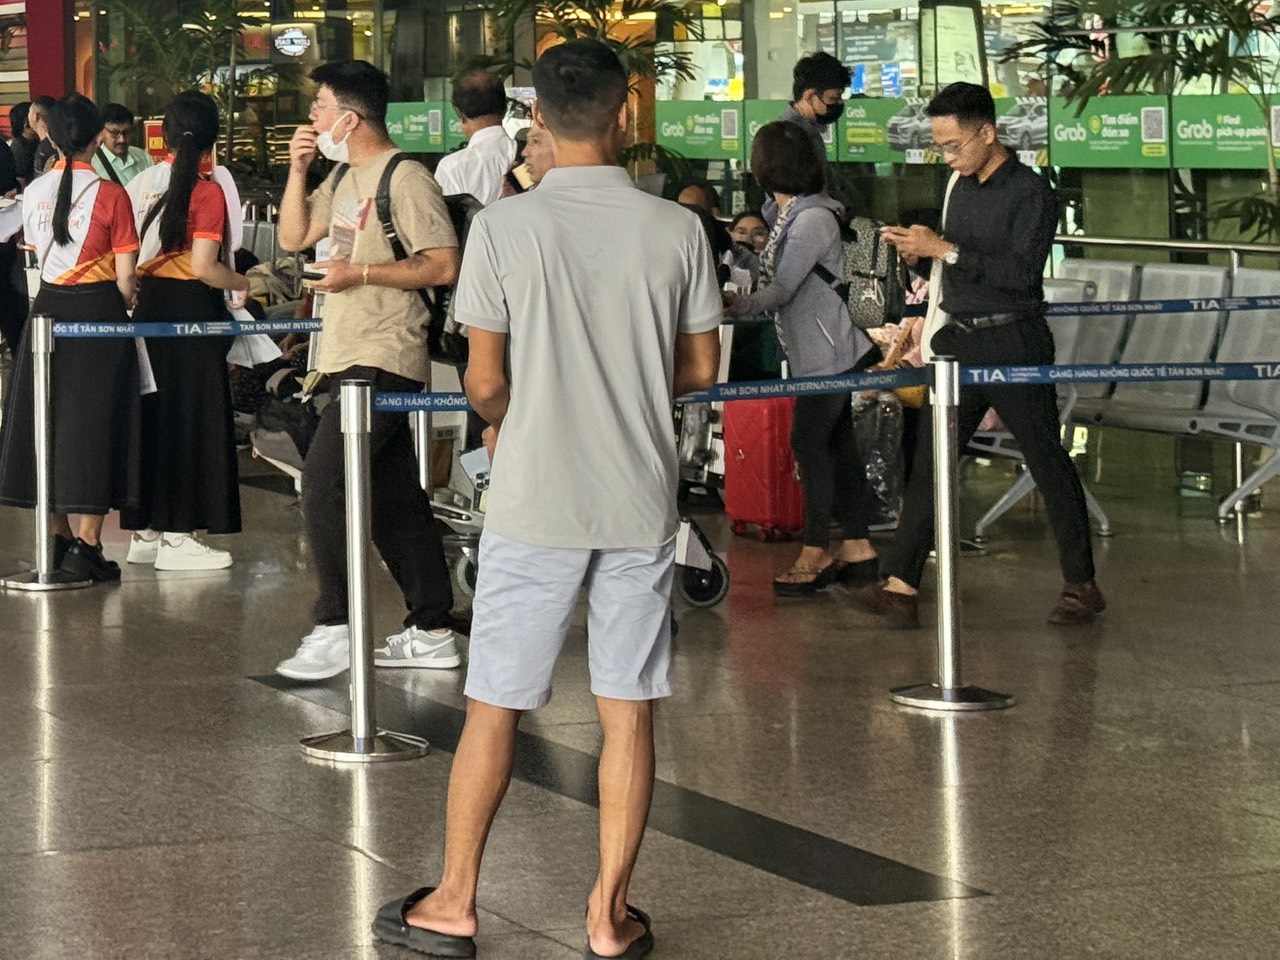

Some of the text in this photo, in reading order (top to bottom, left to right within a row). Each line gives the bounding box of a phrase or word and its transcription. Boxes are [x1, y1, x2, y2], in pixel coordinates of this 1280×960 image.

[1223, 114, 1241, 125] Find
[662, 121, 685, 137] Grab
[1054, 122, 1087, 142] Grab
[1176, 119, 1213, 139] Grab
[1216, 126, 1245, 138] pick-up
[1189, 299, 1220, 311] TIA
[80, 323, 96, 333] TÂN
[98, 323, 115, 333] SƠN
[173, 323, 202, 335] TIA
[293, 321, 323, 330] INTERNA
[969, 368, 1006, 383] TIA
[719, 373, 897, 396] TAN SON NHAT INTERNATIONAL AIRPORT
[433, 394, 468, 406] KHÔNG
